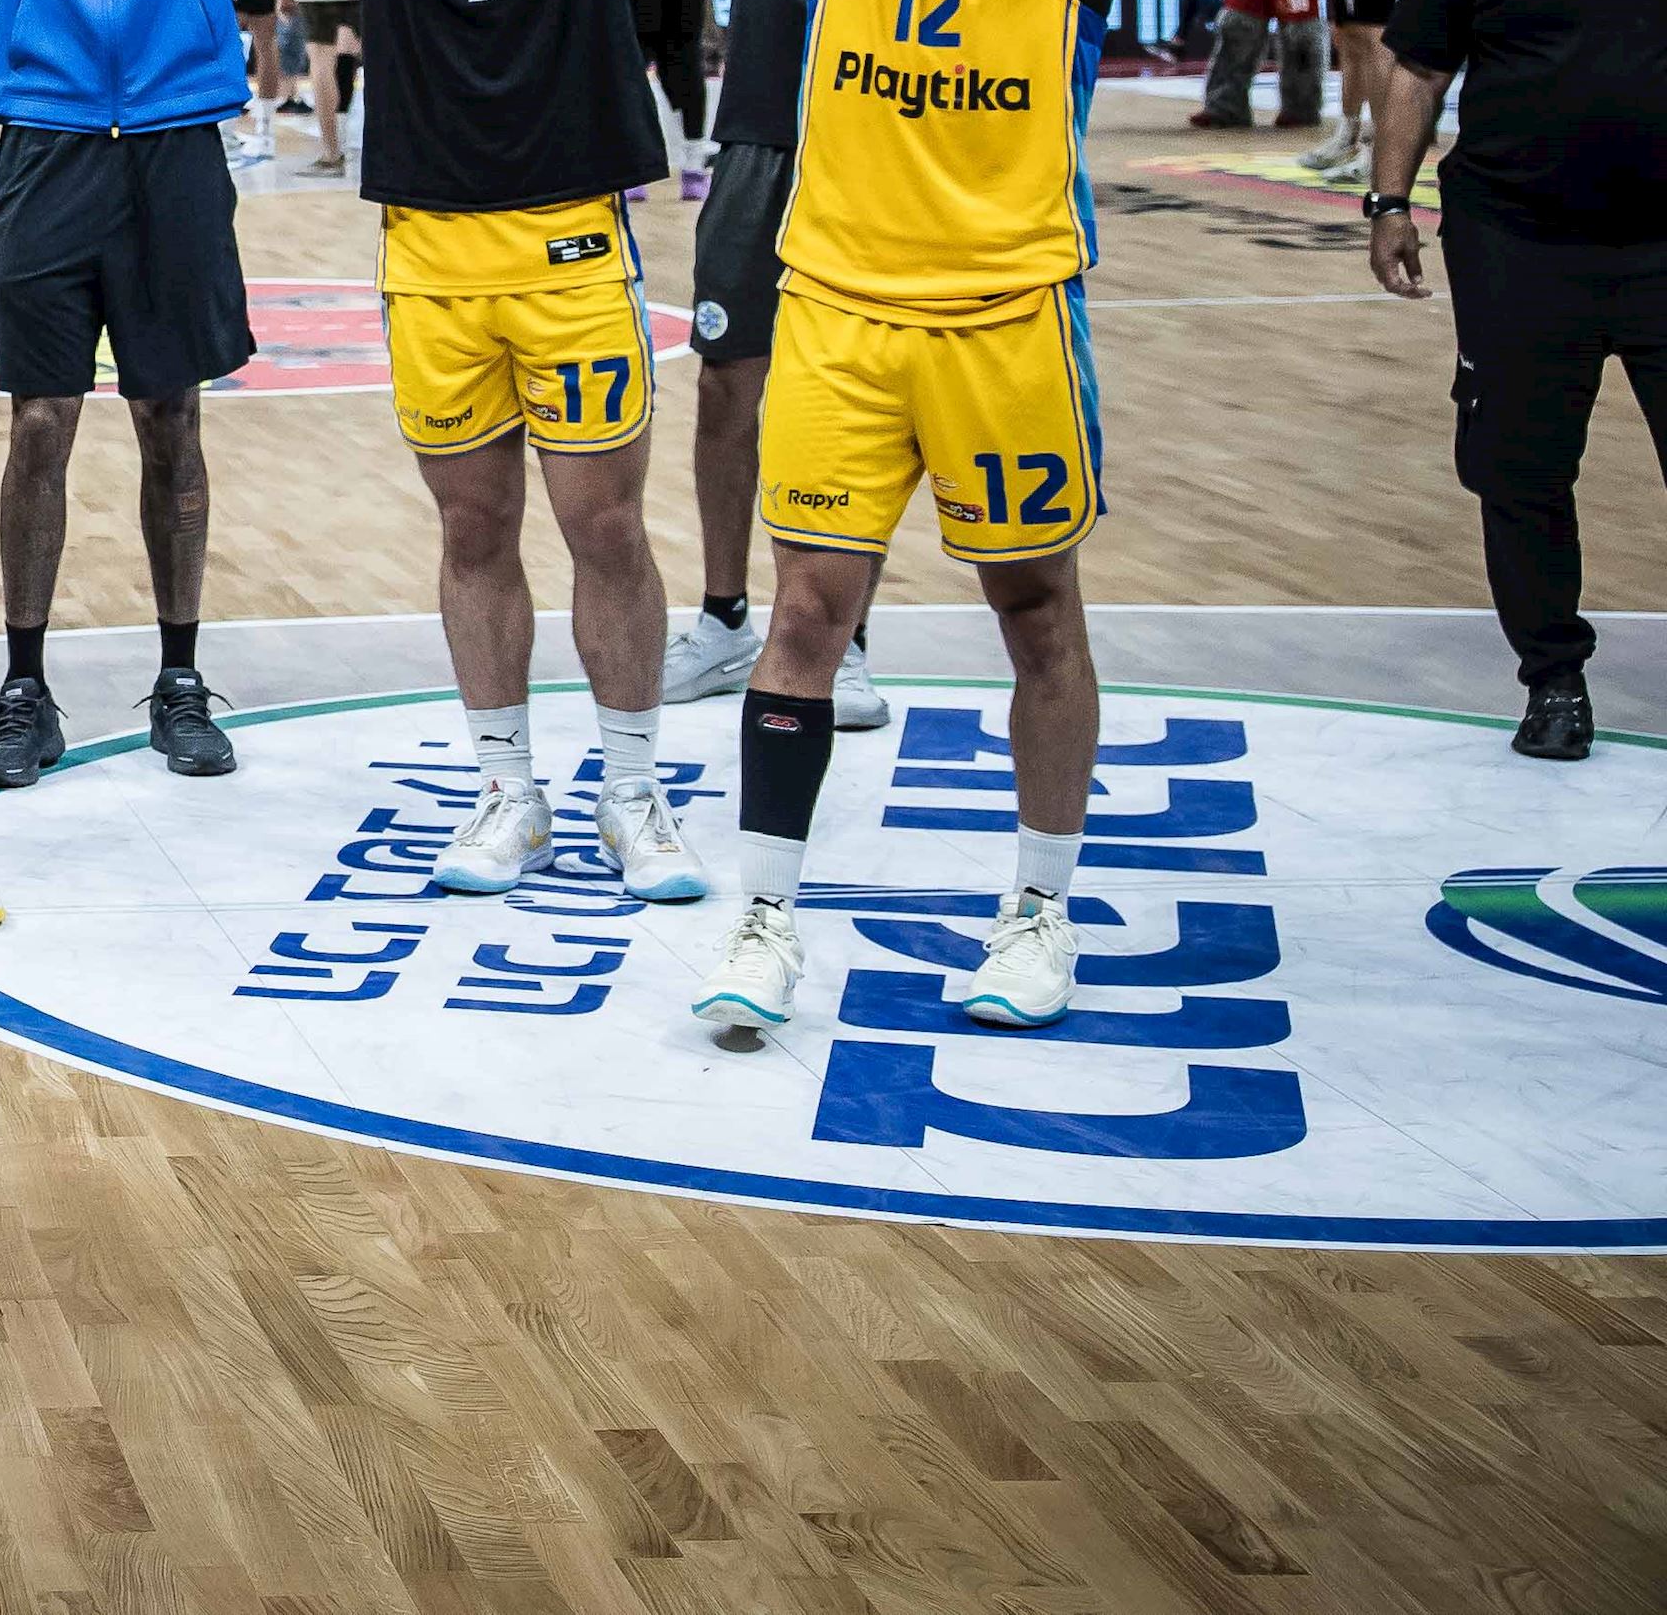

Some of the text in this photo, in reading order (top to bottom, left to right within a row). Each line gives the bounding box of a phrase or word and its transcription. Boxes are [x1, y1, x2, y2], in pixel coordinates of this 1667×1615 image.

[834, 51, 1030, 118] Playtika
[425, 405, 474, 432] Rapyd
[556, 356, 630, 423] 17
[788, 489, 849, 510] Rapyd
[974, 452, 1071, 525] 12
[232, 921, 430, 1002] הכי
[787, 707, 1308, 1160] בנק יהב
[443, 934, 633, 1016] הכי
